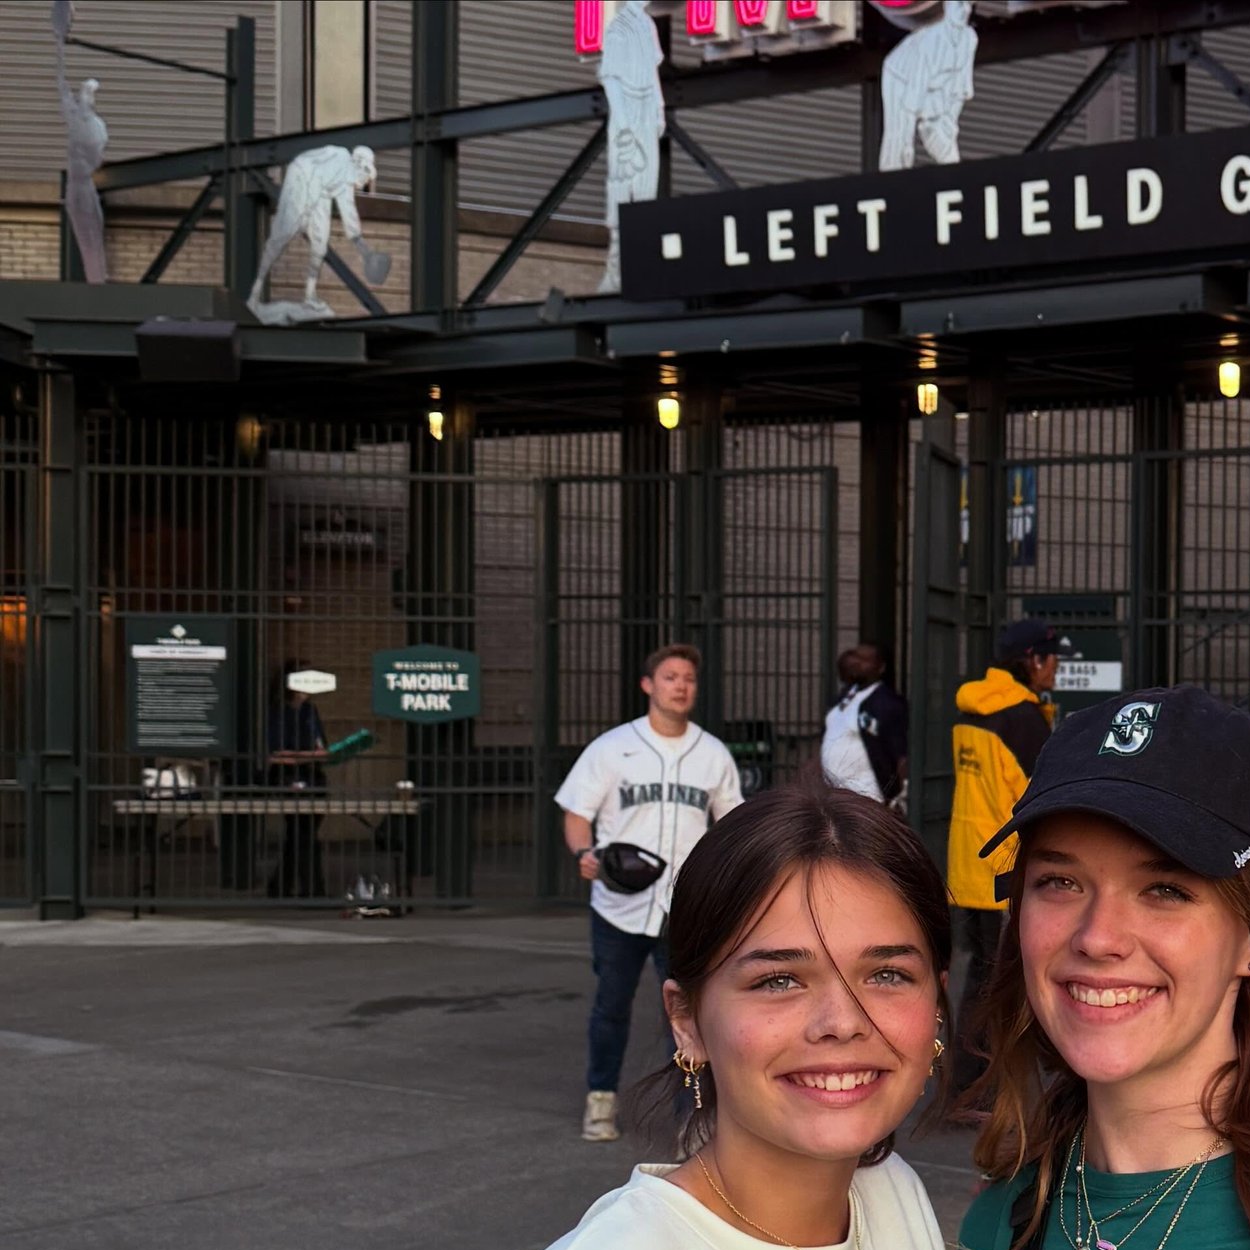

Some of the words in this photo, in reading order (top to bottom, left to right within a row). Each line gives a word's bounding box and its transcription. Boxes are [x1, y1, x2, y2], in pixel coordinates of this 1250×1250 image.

[721, 198, 888, 267] LEFT
[935, 167, 1165, 247] FIELD
[1069, 664, 1097, 676] BAGS
[384, 673, 470, 691] T-MOBILE
[1060, 677, 1090, 687] OWED
[400, 692, 452, 712] PARK
